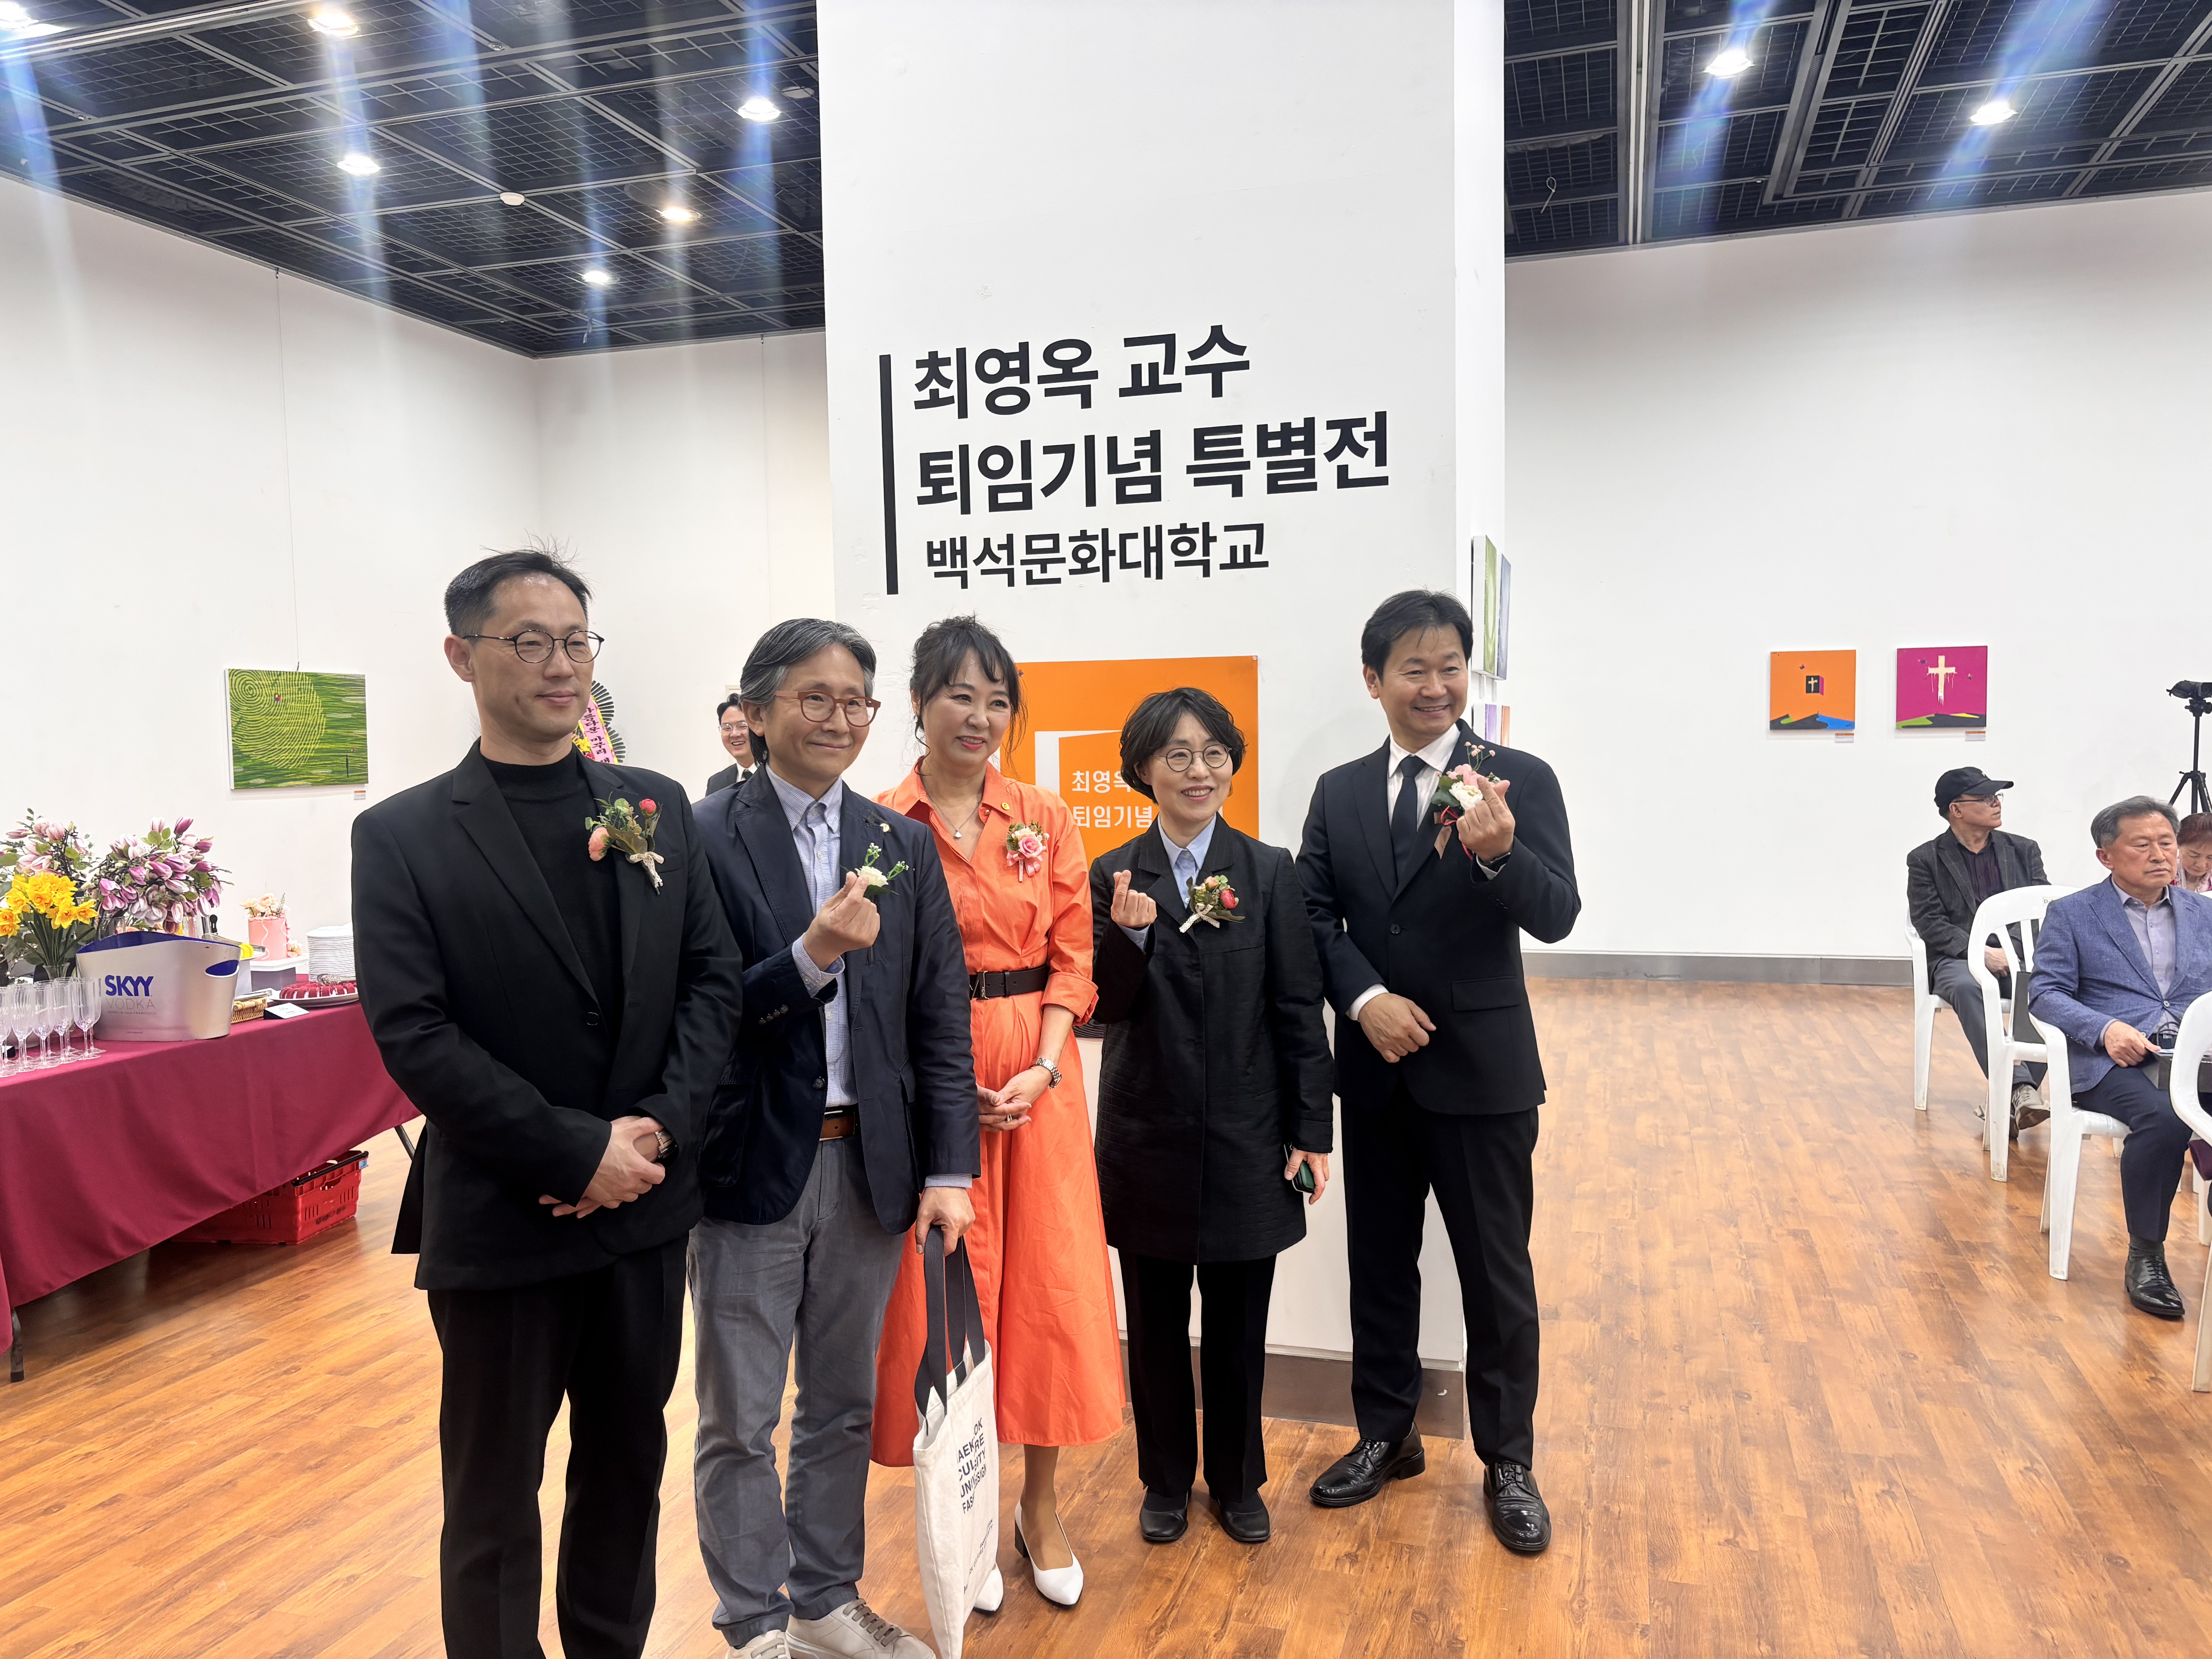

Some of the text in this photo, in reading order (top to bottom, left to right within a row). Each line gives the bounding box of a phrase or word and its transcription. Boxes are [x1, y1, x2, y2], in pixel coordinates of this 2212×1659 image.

[914, 325, 1249, 419] 최영옥 교수
[917, 411, 1388, 515] 퇴임기념 특별전
[927, 522, 1268, 589] 백석문화대학교
[1072, 770, 1131, 793] 최영옥
[1073, 805, 1152, 828] 퇴임기념
[105, 975, 154, 996] SKYY
[106, 998, 155, 1010] VODKA
